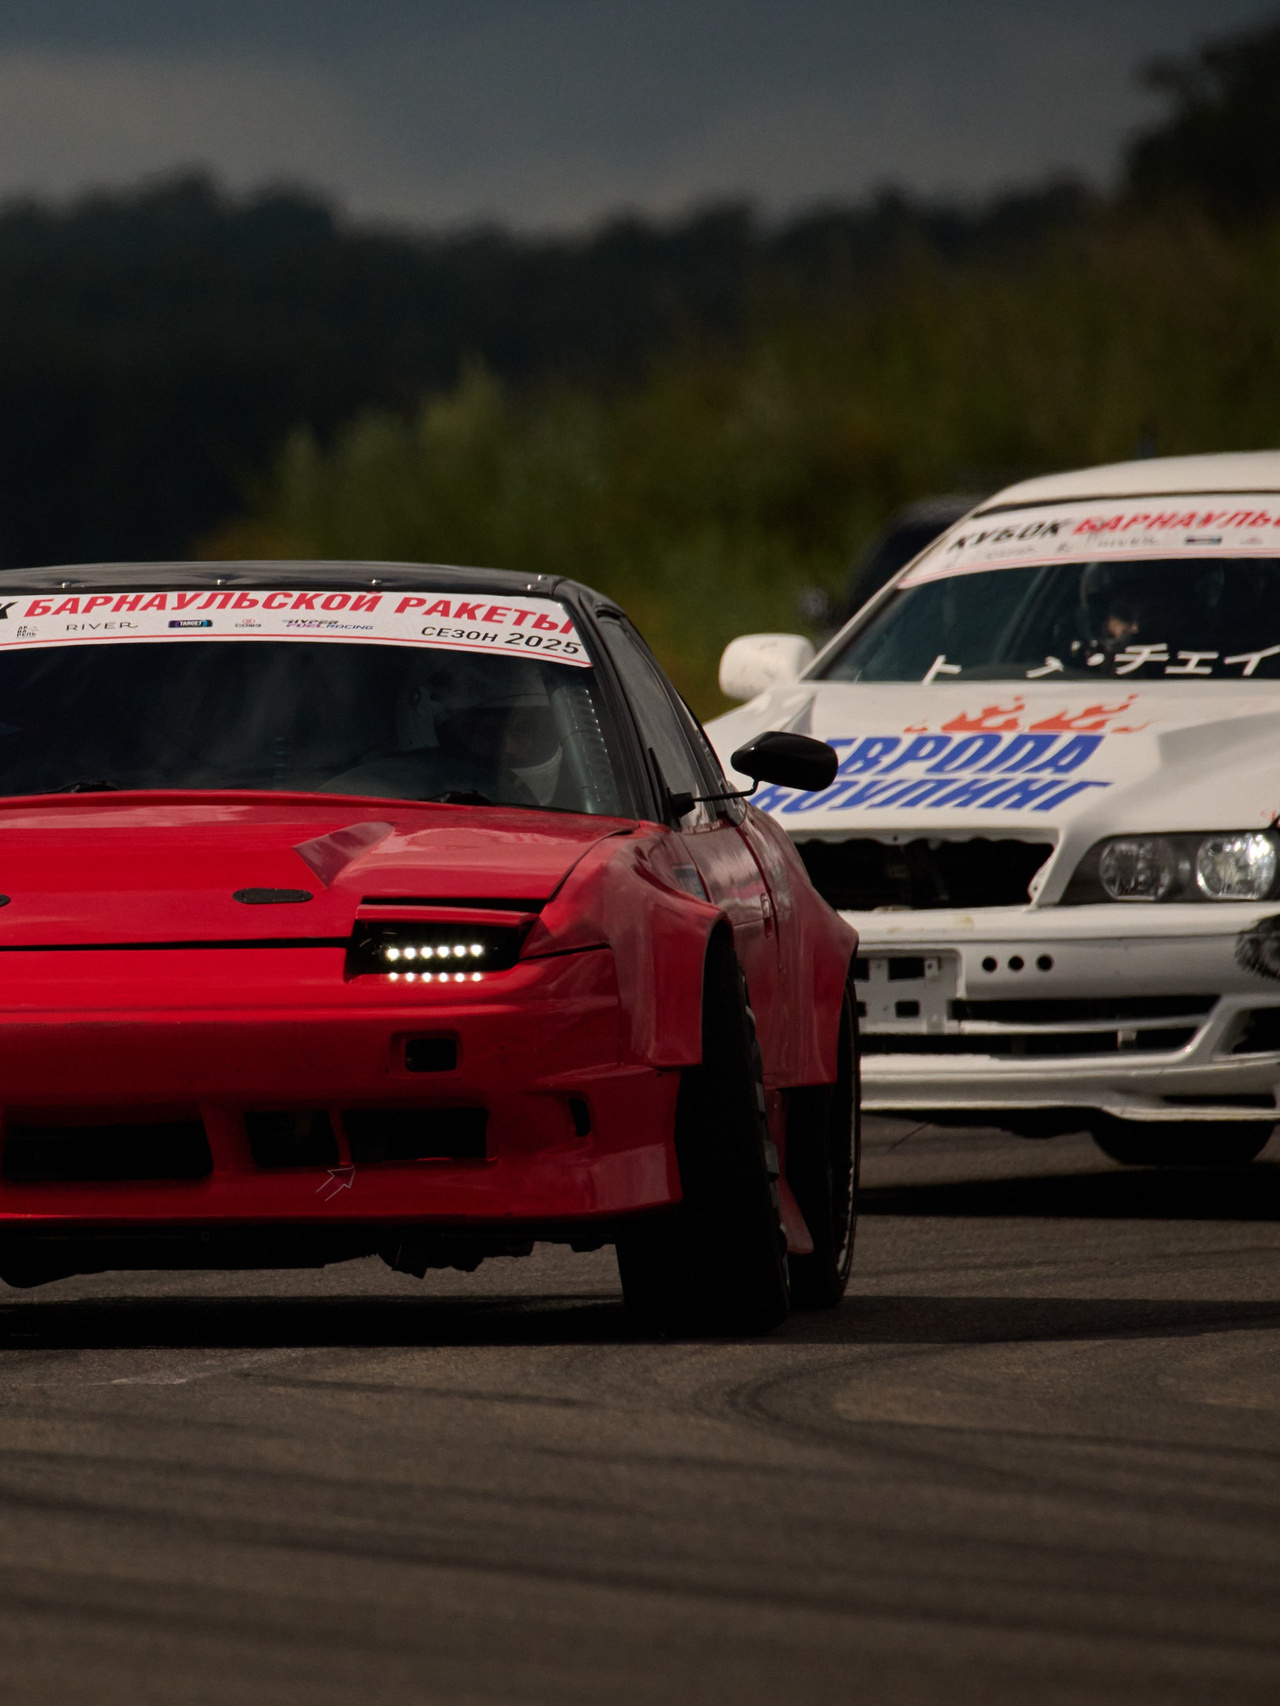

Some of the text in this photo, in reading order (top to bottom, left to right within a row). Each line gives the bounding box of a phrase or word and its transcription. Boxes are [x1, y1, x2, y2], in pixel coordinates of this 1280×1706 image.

[1073, 509, 1280, 535] БАРНАУЛЬ
[23, 590, 383, 618] БАРНАУЛЬСКОЙ
[394, 597, 575, 635] РАКЕТЫ
[65, 621, 139, 632] RIVER
[421, 626, 582, 655] СЕЗОН 2025
